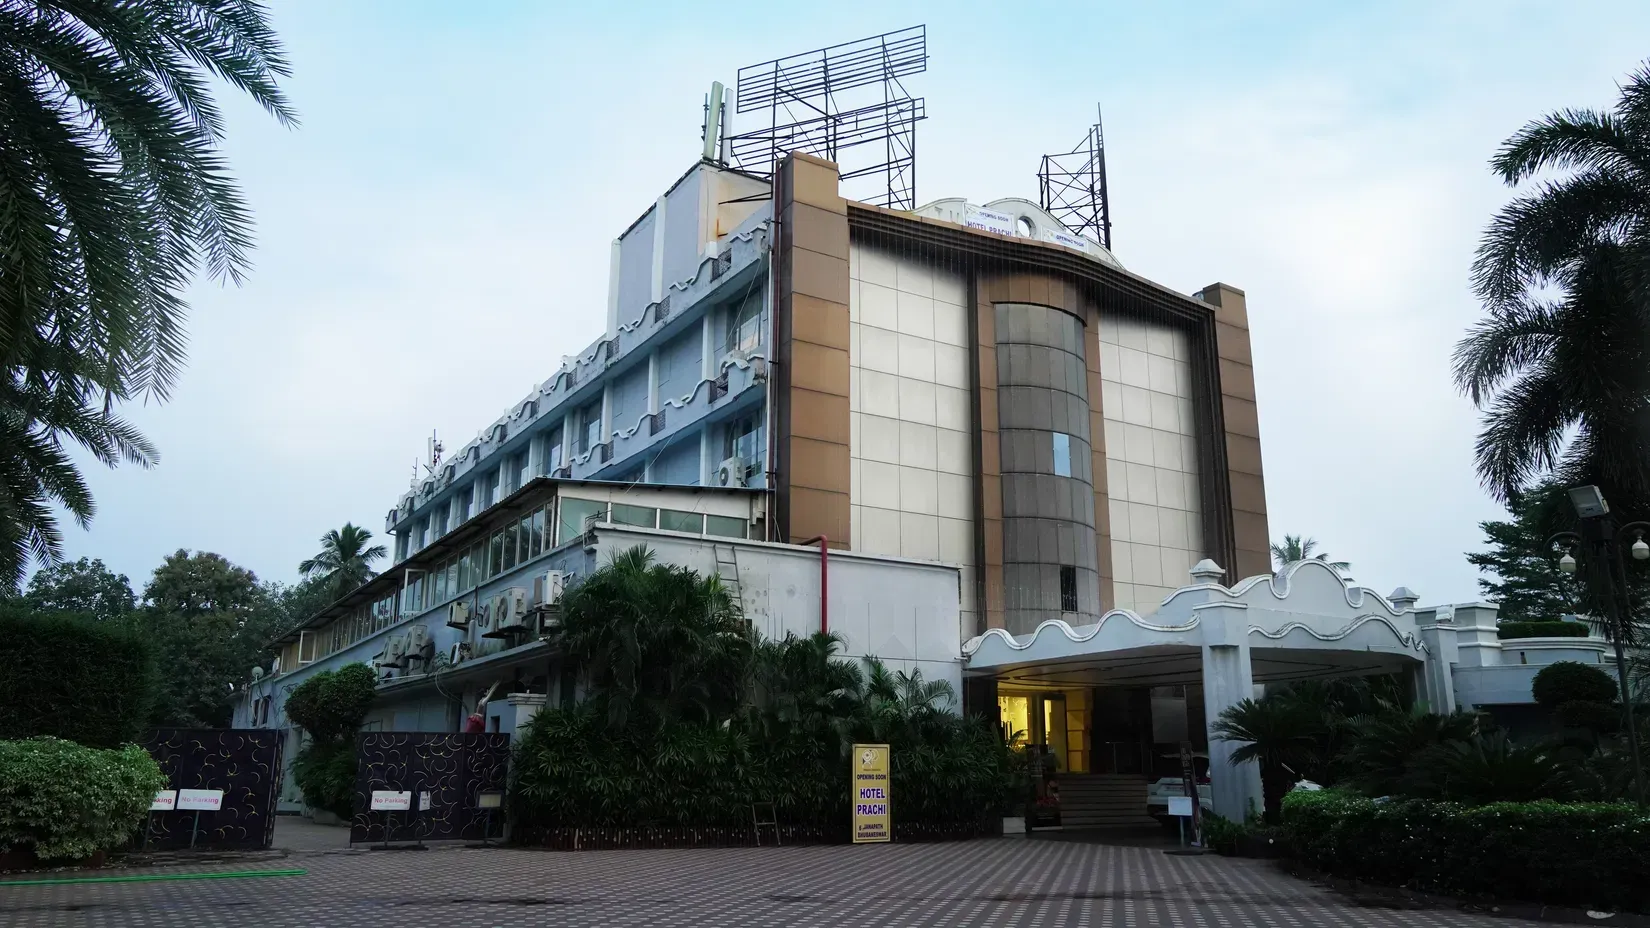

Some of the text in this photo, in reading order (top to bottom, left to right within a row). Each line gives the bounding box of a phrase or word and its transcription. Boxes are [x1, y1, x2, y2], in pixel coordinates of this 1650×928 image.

[860, 788, 885, 799] HOTEL
[192, 796, 219, 805] Parking
[384, 797, 408, 805] Parking
[857, 804, 886, 815] PRACHI
